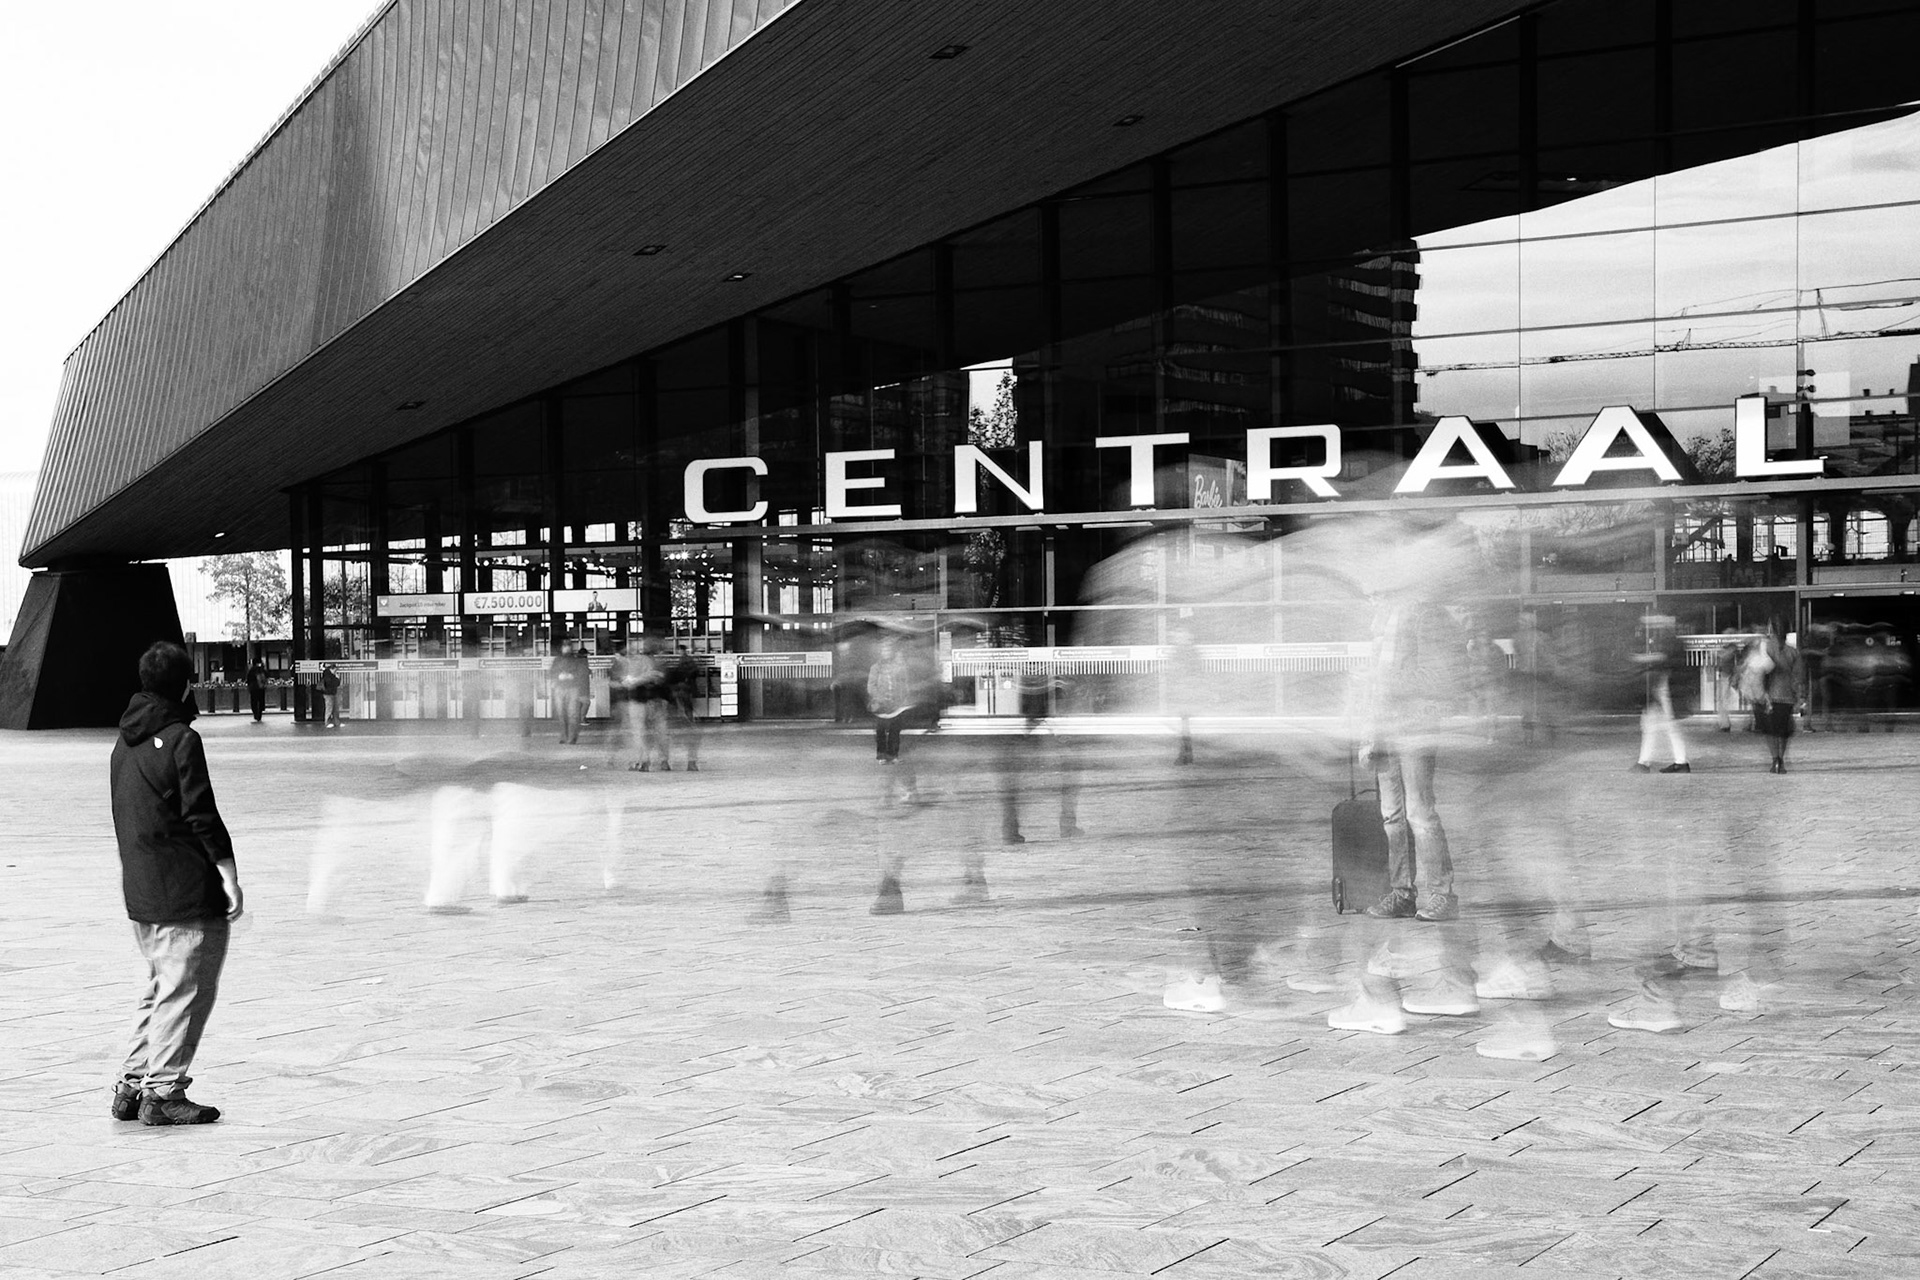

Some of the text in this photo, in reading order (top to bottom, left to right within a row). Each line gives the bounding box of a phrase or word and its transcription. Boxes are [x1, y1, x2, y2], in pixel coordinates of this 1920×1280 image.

[684, 396, 1825, 523] CENTRAAL
[1193, 473, 1223, 509] Barbie
[474, 595, 542, 609] €7.500.000
